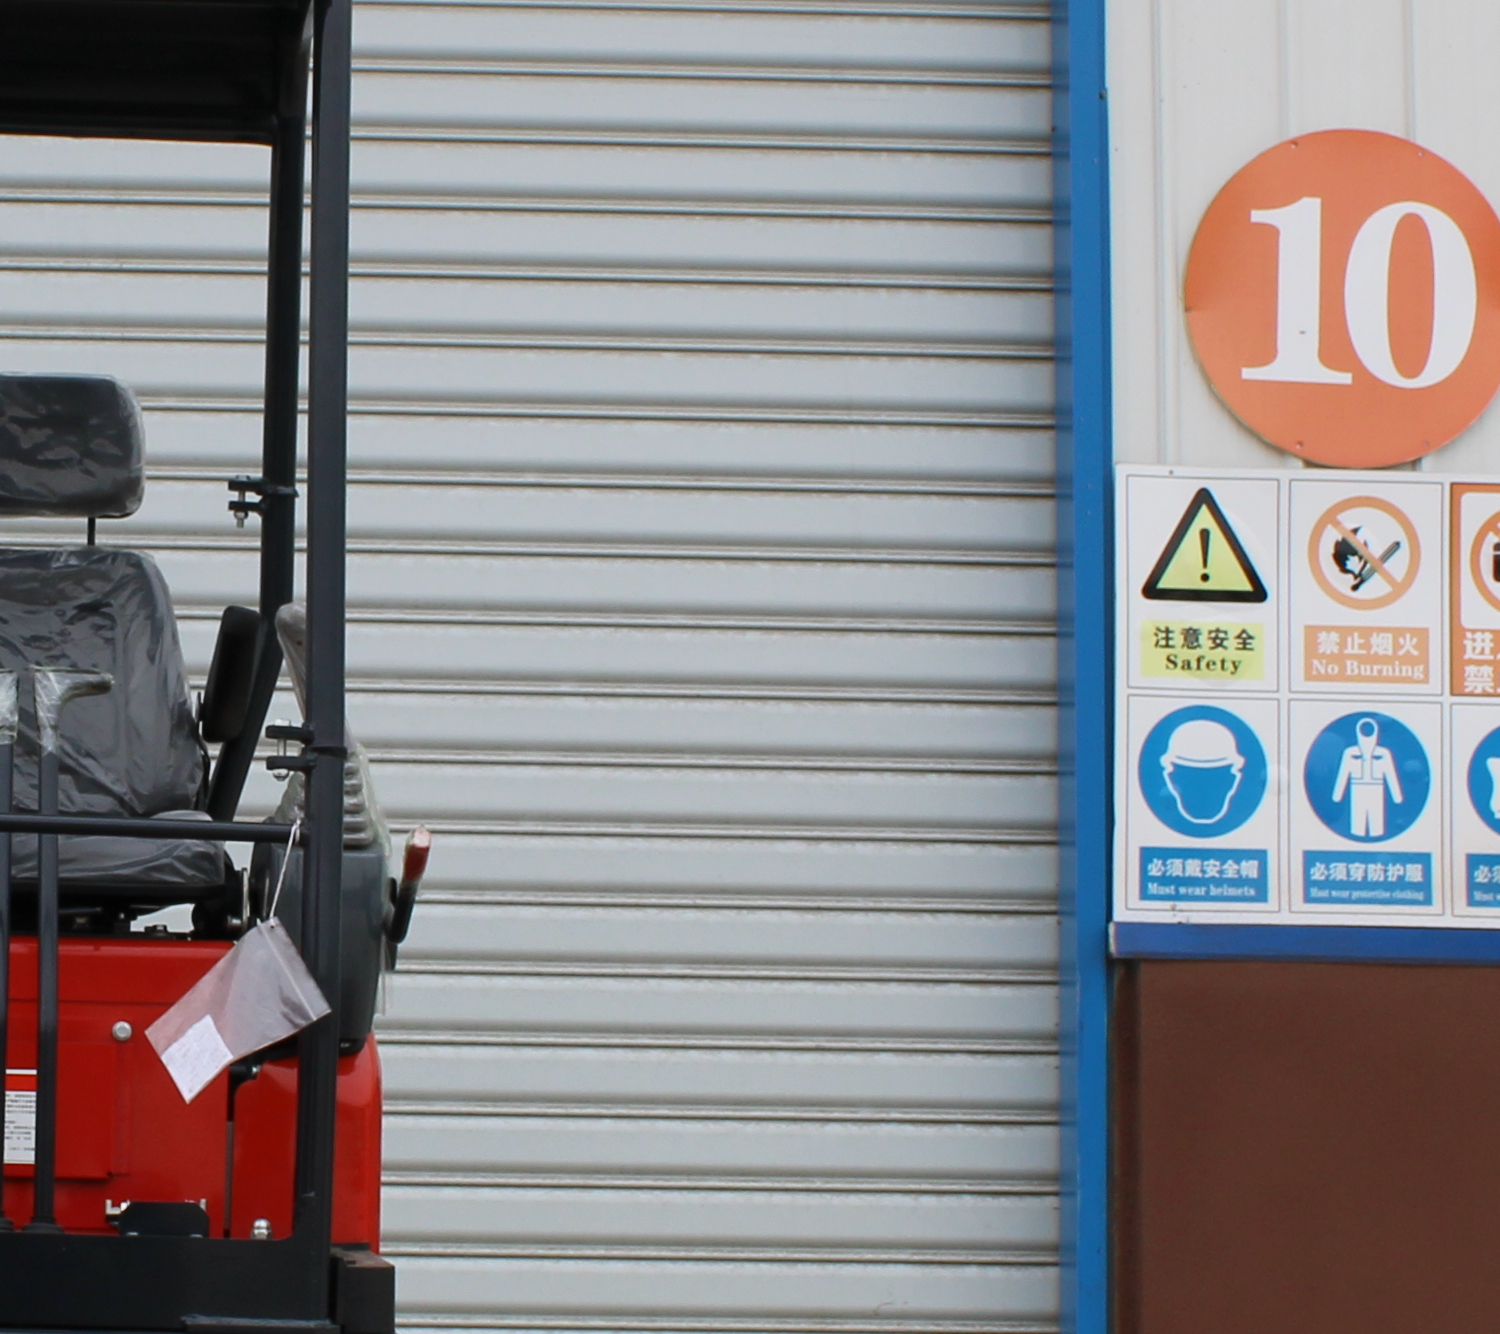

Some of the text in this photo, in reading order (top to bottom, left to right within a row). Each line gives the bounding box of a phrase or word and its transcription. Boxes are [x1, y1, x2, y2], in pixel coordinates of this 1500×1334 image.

[1241, 196, 1477, 389] 10
[1153, 626, 1255, 651] 注意安全
[1316, 631, 1419, 656] 禁止烟火
[1165, 654, 1242, 675] Safety
[1311, 659, 1425, 680] No Burning
[1147, 858, 1259, 879] 必须戴安全帽
[1310, 862, 1424, 883] 必须穿防护服
[1147, 882, 1256, 898] Must wear helmets
